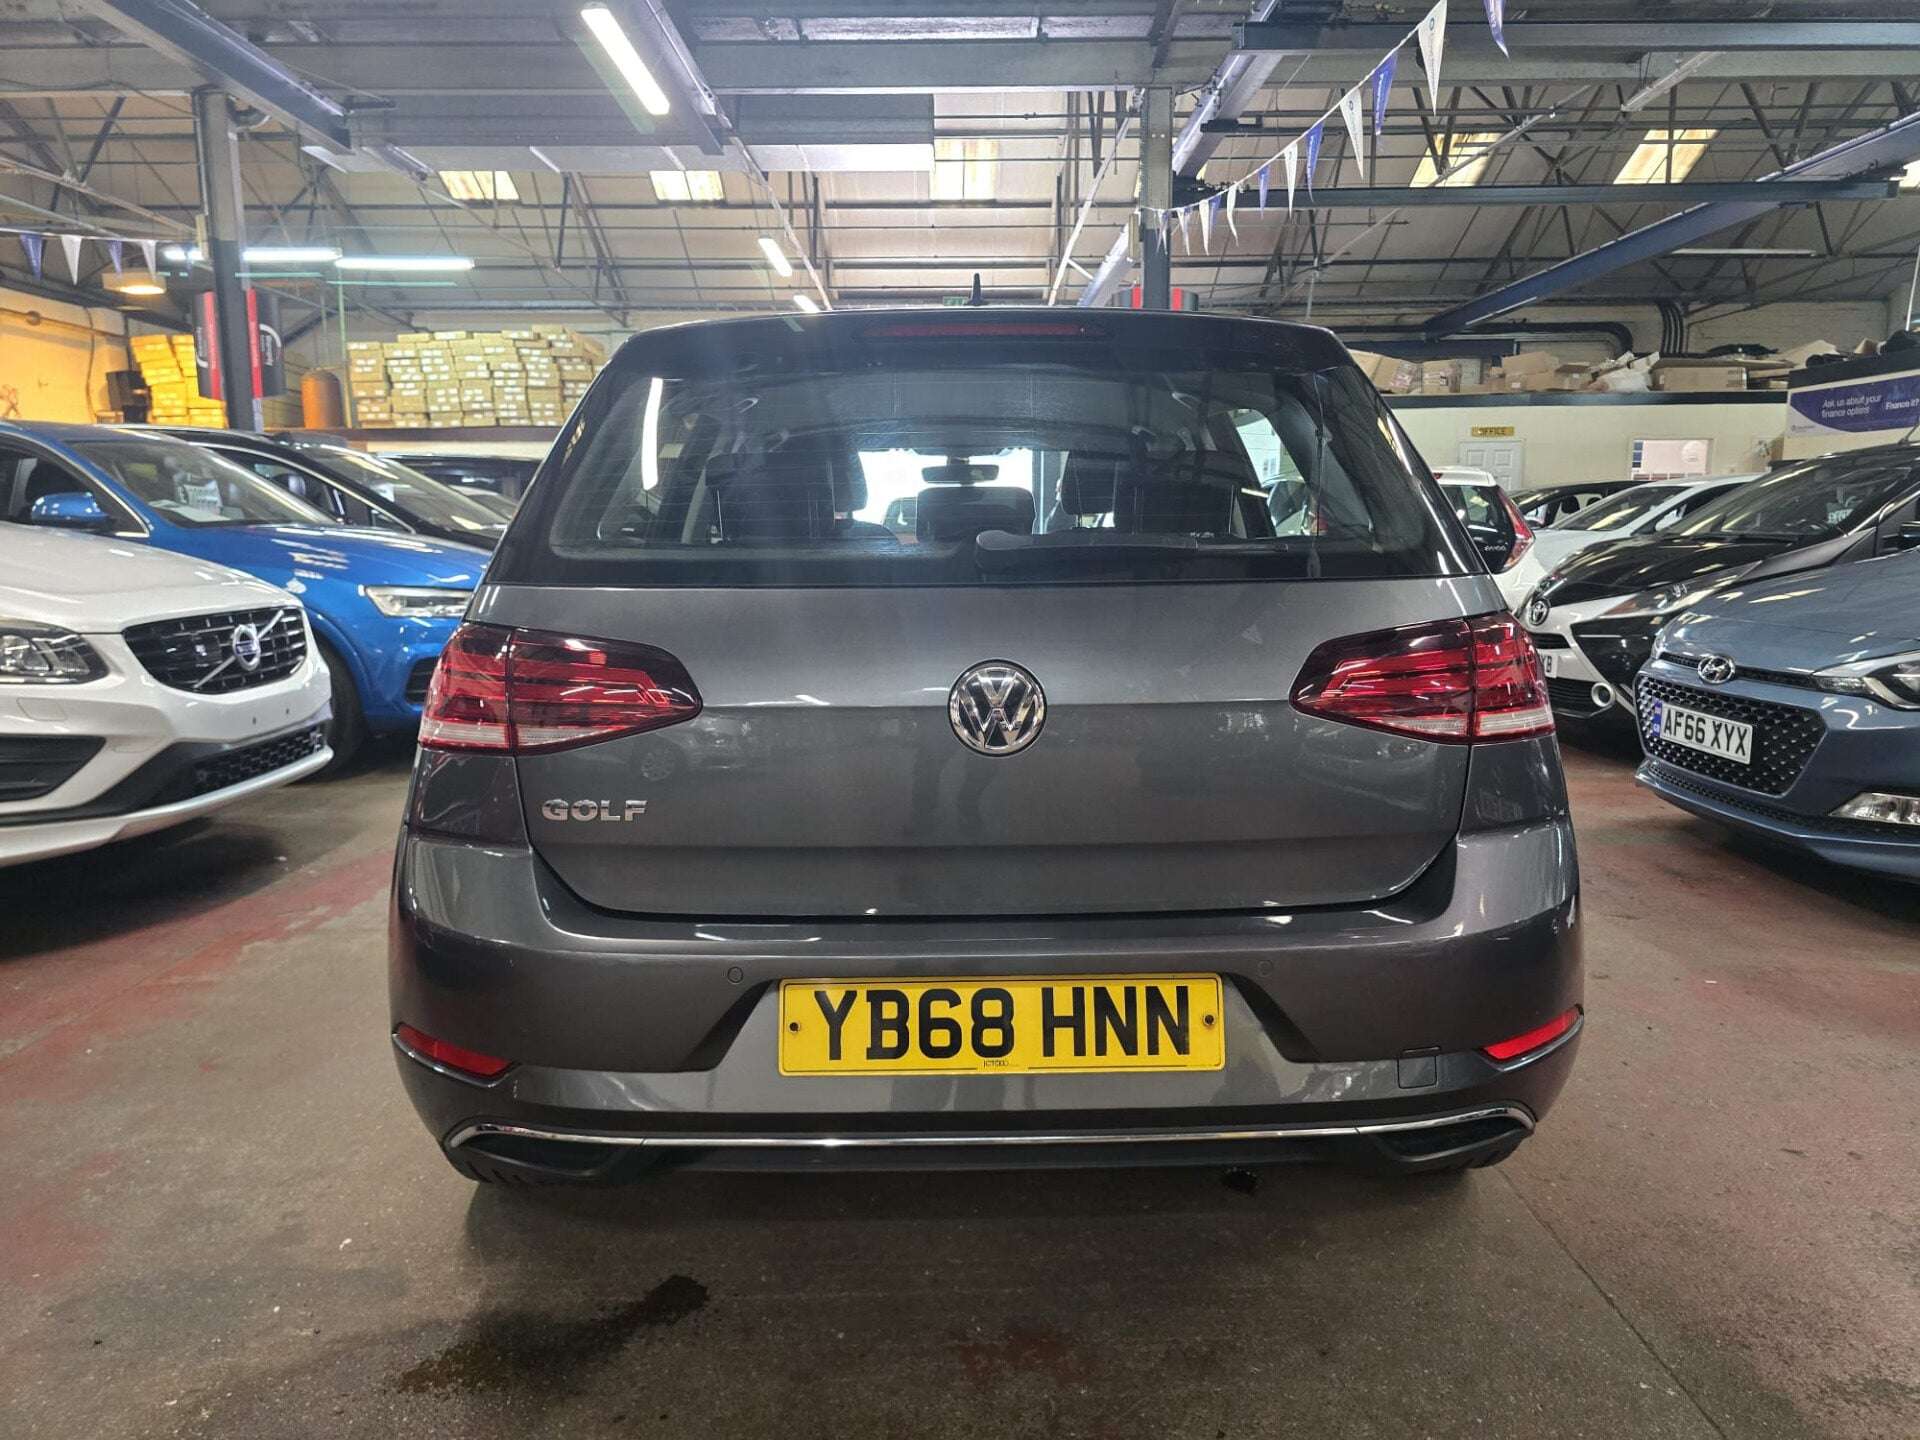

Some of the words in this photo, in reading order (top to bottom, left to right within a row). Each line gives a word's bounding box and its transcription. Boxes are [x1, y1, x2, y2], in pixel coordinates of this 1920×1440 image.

[1821, 409, 1846, 418] finance
[1822, 400, 1835, 409] Ask
[1836, 399, 1845, 407] us
[1846, 396, 1865, 406] about
[1864, 394, 1882, 406] your
[1663, 708, 1706, 744] AF66
[1710, 720, 1748, 757] XYX
[541, 798, 649, 822] GOLF
[812, 987, 1016, 1061] YB68
[1040, 985, 1191, 1057] HNN
